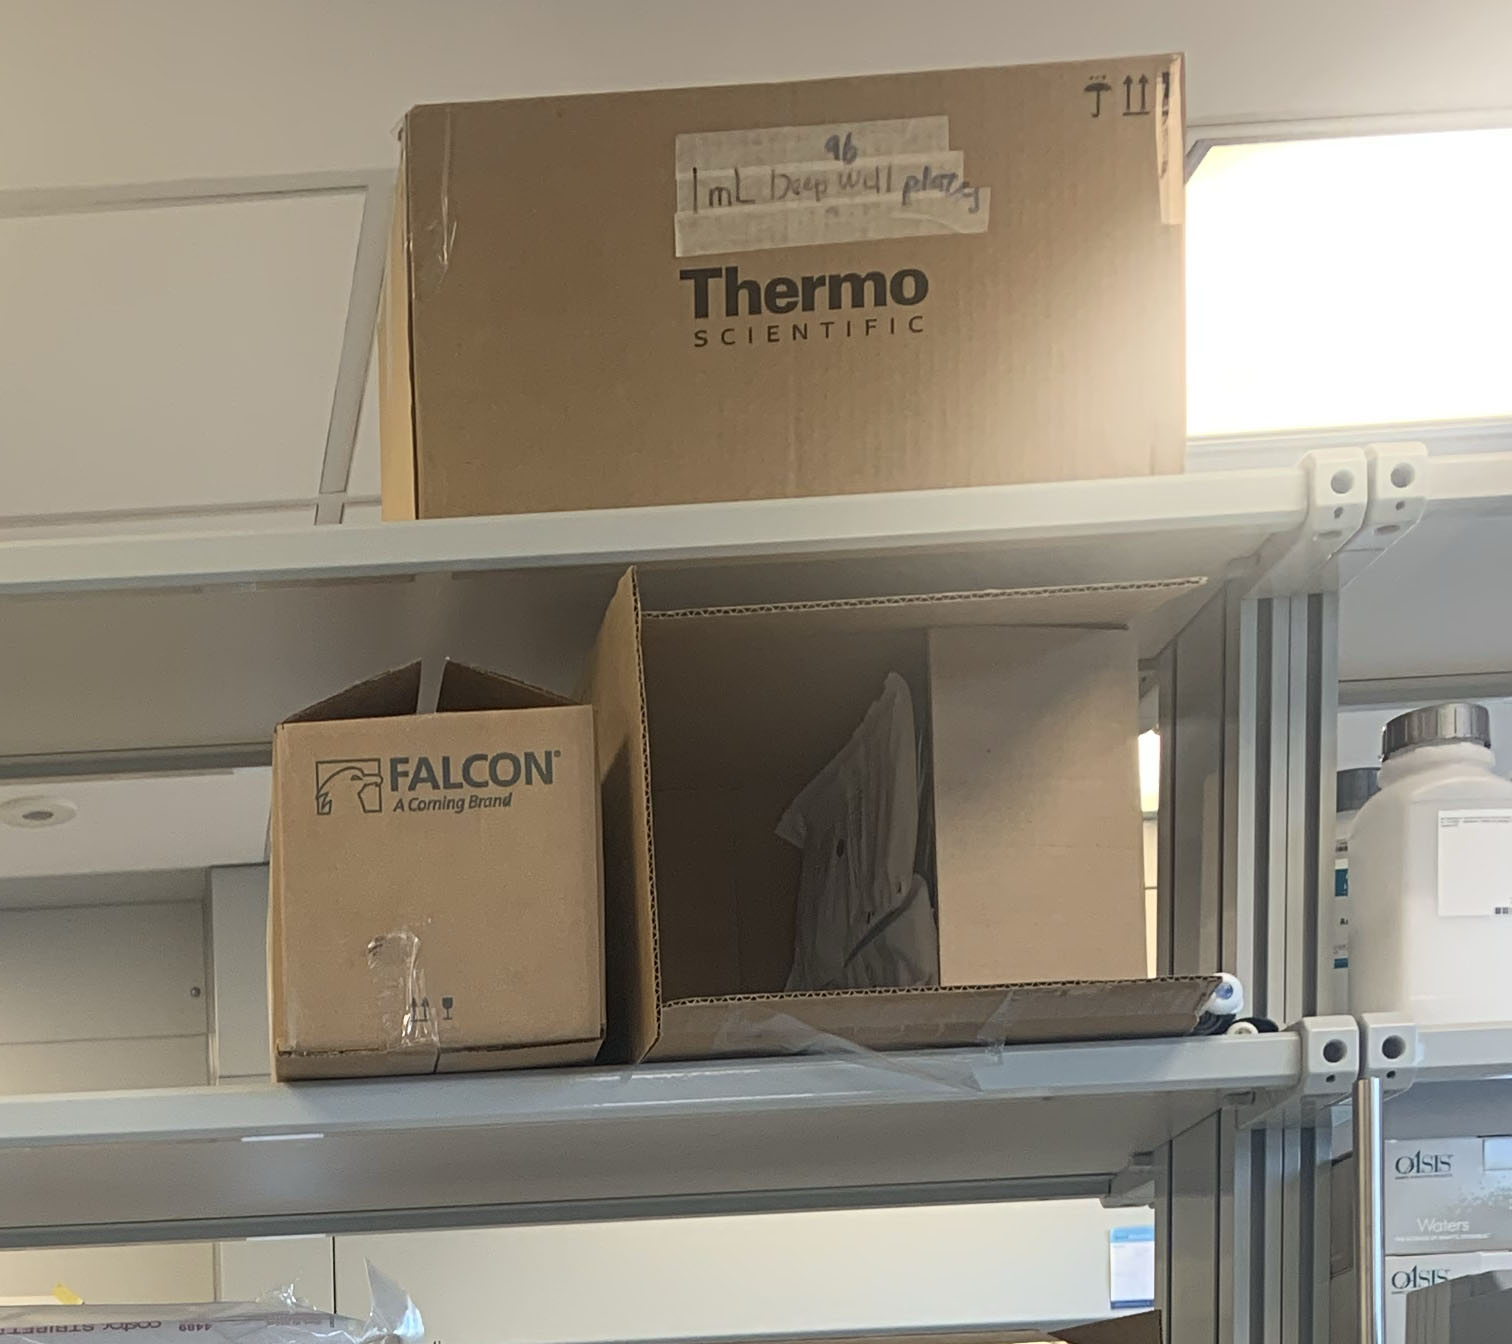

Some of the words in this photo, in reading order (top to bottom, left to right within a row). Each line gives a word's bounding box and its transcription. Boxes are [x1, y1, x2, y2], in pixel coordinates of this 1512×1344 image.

[770, 169, 828, 202] Deep
[679, 266, 929, 320] Thermo
[693, 315, 925, 348] SCIENTIFIC
[392, 800, 405, 813] A
[408, 795, 465, 814] Corning
[468, 792, 513, 809] Brand
[1416, 1217, 1471, 1234] Waters
